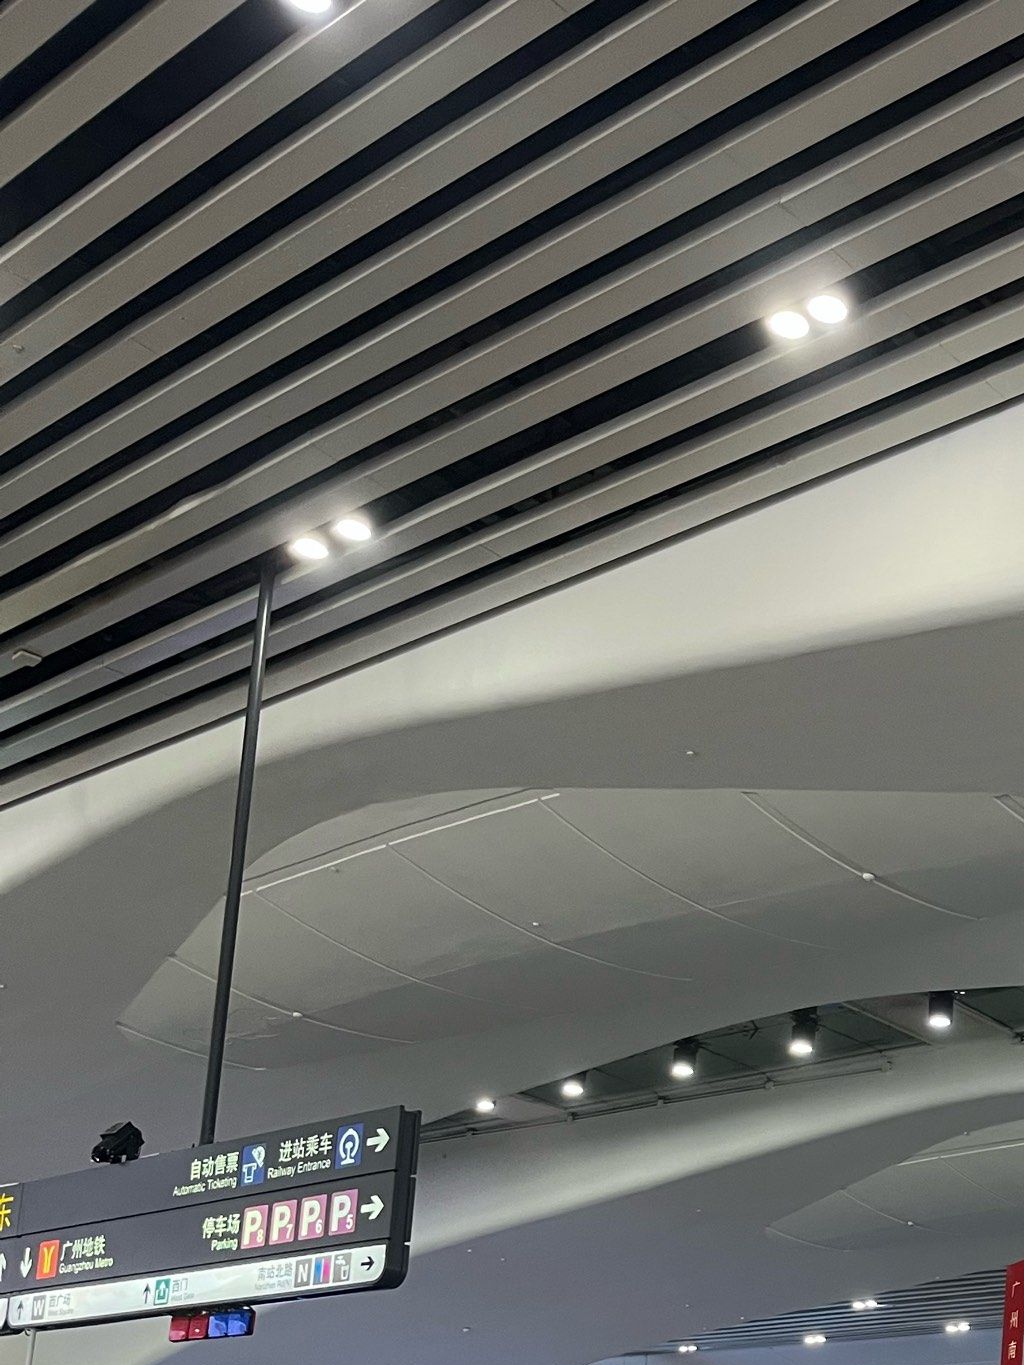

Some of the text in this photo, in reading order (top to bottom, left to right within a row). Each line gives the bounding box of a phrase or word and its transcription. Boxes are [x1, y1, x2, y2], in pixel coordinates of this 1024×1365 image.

[279, 1133, 334, 1163] 进站乘车
[190, 1151, 240, 1181] 自动售票
[267, 1159, 332, 1179] Railway Entrance
[173, 1177, 237, 1196] Automatic Ticketing
[202, 1213, 241, 1239] 停车场
[60, 1235, 106, 1261] 广州地铁
[211, 1237, 238, 1251] Parking
[59, 1257, 114, 1274] Guangzhou Metro
